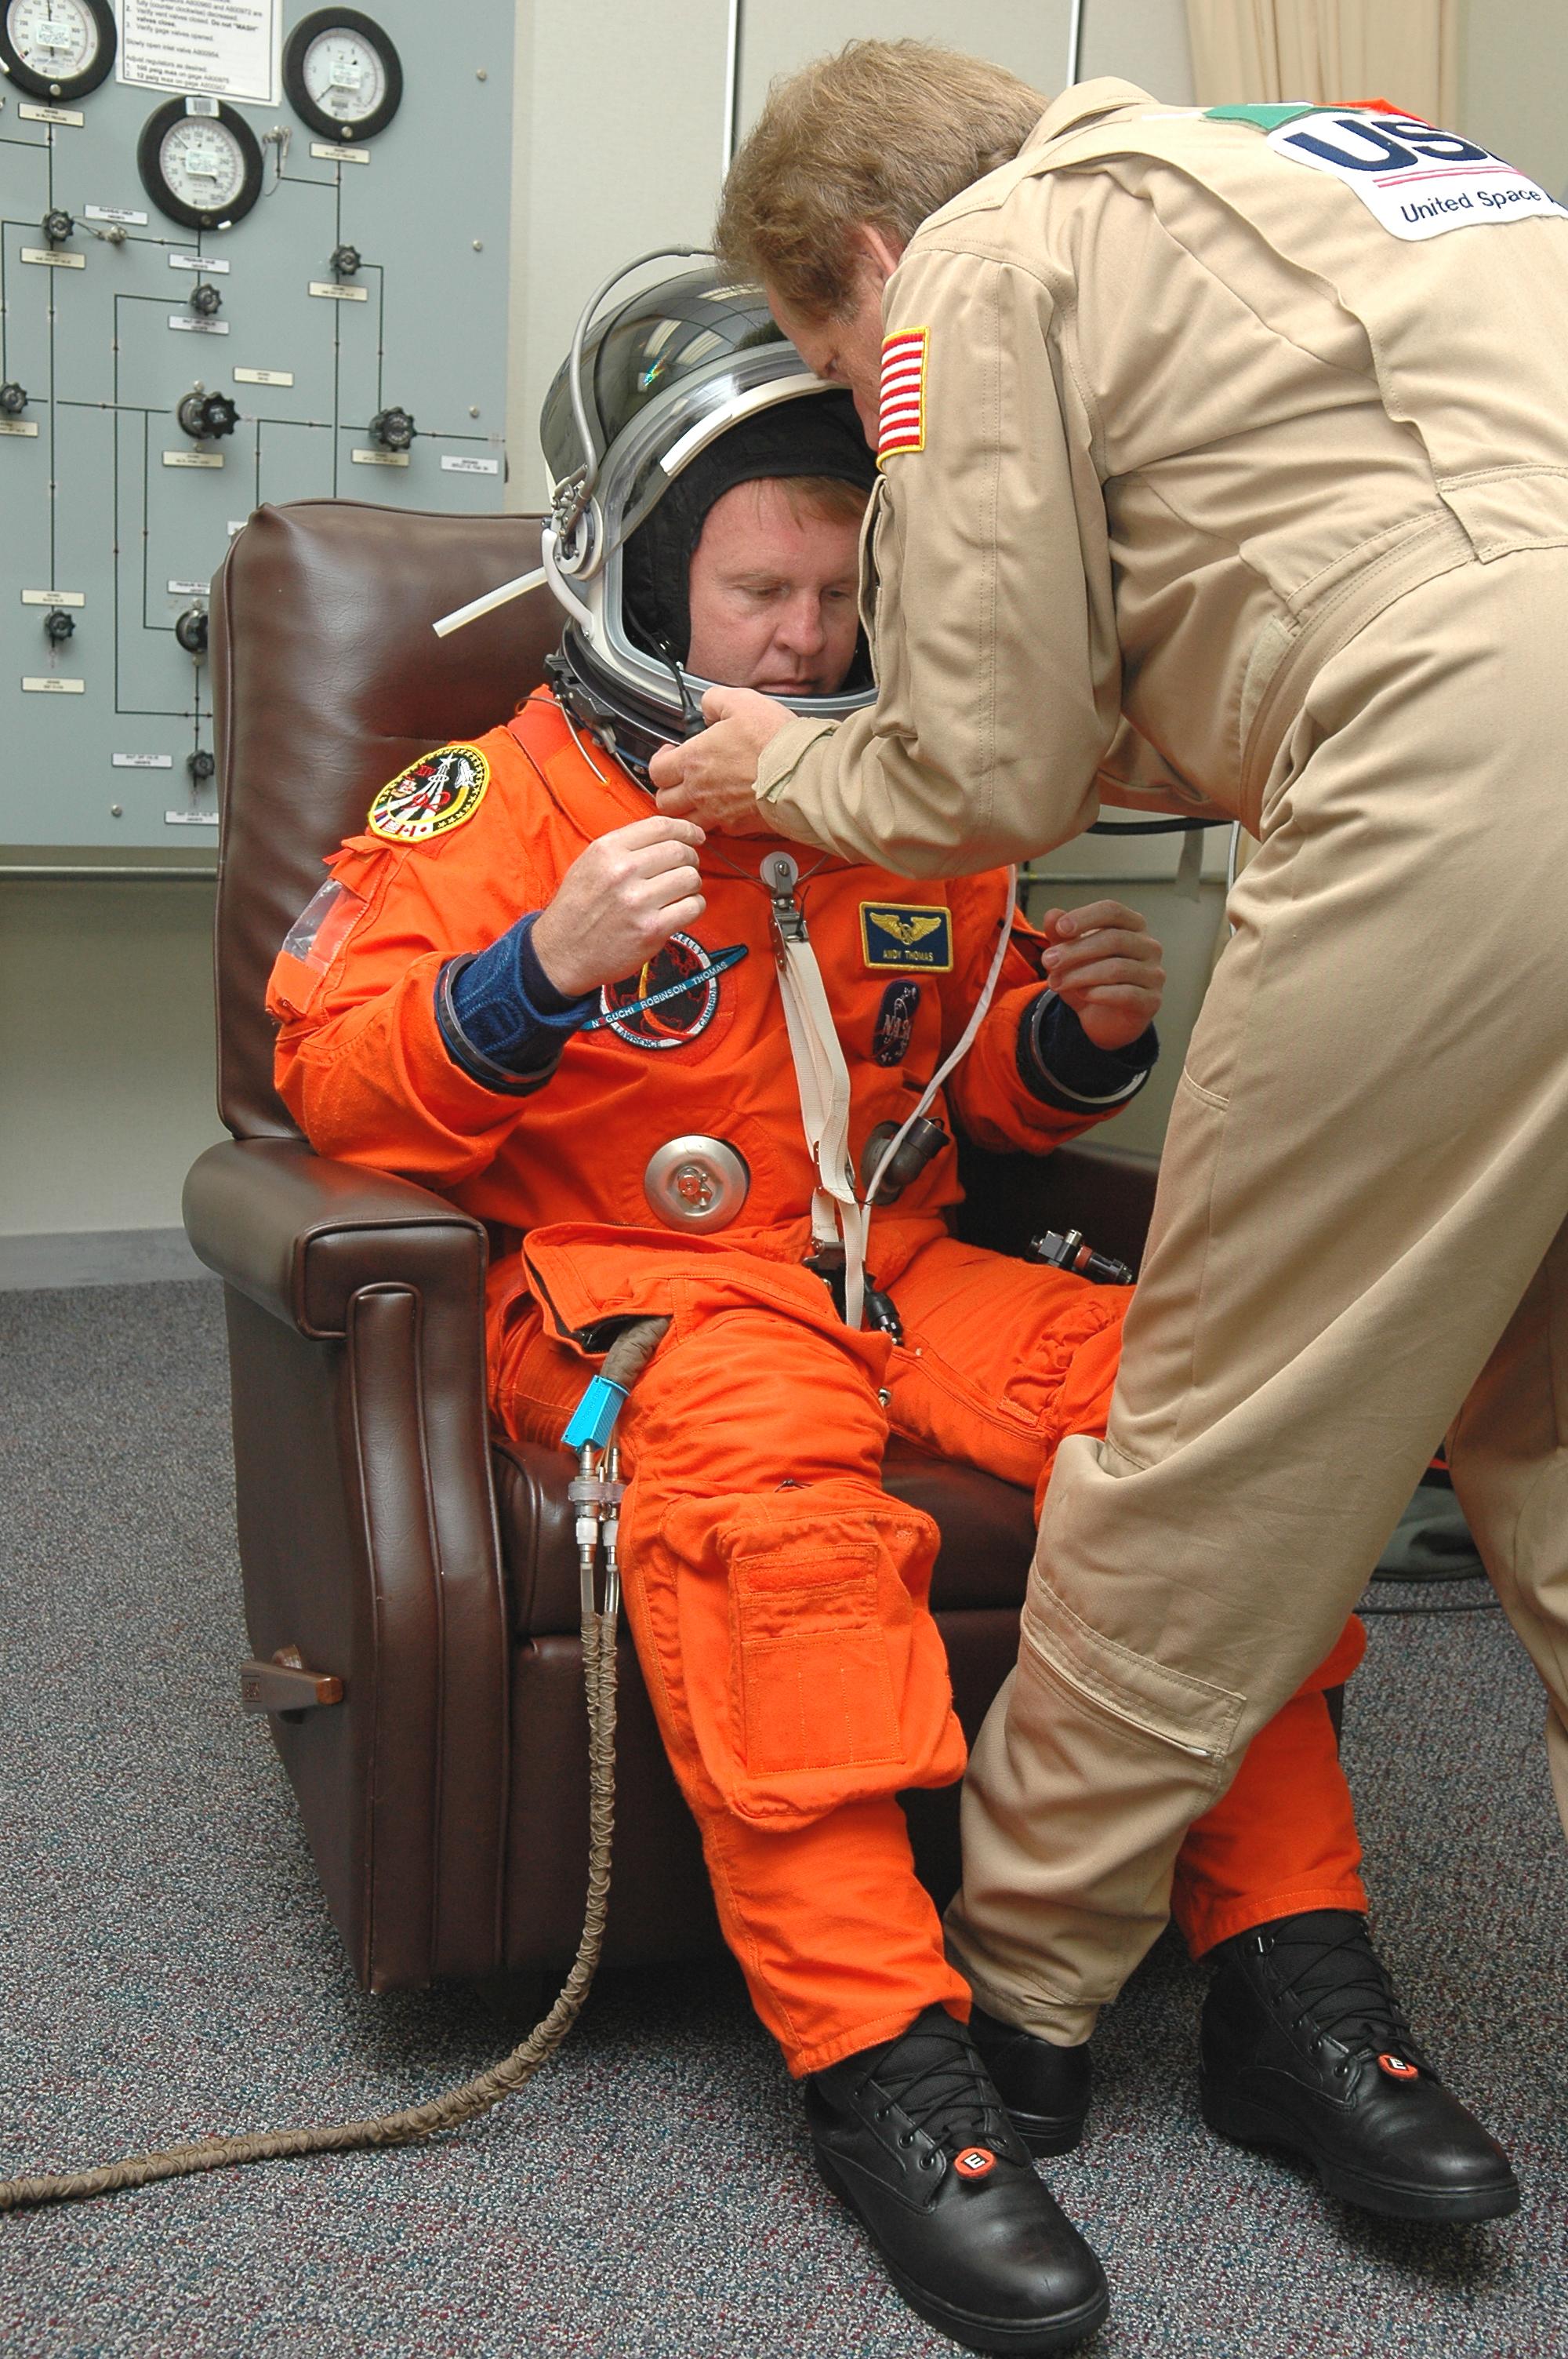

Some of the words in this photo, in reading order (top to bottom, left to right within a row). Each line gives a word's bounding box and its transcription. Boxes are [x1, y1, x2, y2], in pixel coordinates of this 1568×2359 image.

[1283, 119, 1515, 171] US
[1401, 193, 1474, 223] United
[1477, 190, 1542, 209] Space
[883, 949, 902, 959] ANDY
[904, 950, 934, 962] THOMAS
[640, 983, 688, 1010] ROBINSON
[692, 961, 728, 985] THOMAS
